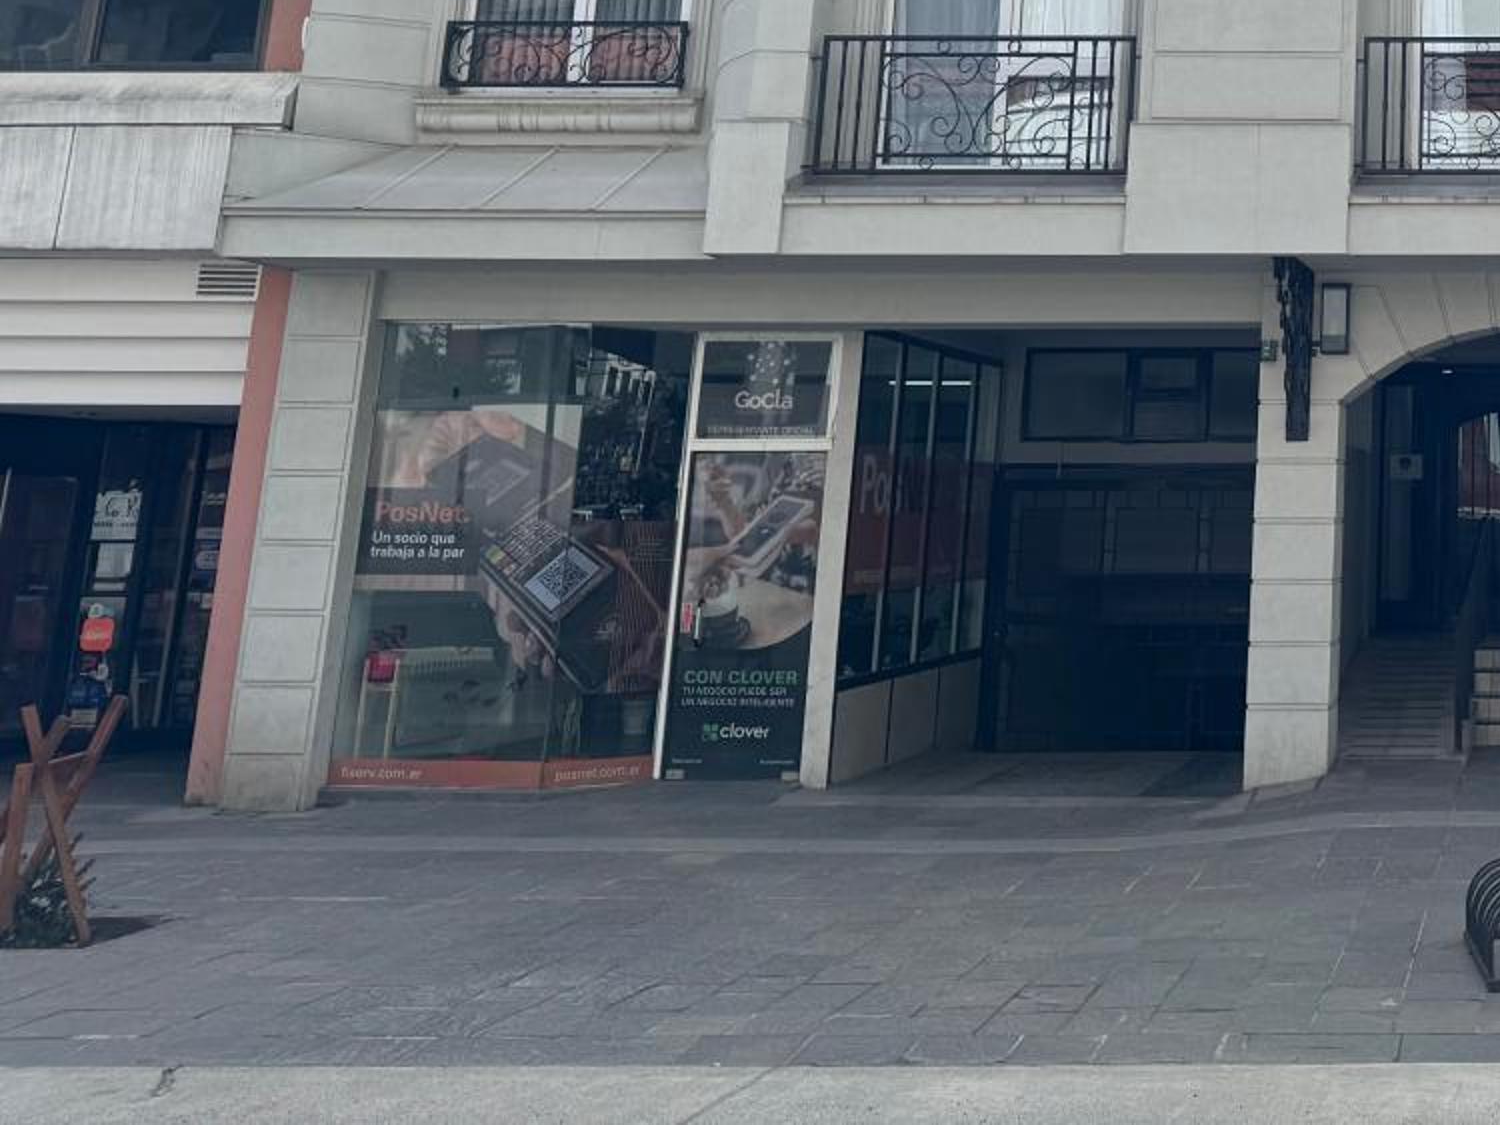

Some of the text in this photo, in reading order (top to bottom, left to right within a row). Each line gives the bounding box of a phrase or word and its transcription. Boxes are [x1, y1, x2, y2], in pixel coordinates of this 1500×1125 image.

[371, 530, 455, 547] Un socio que
[369, 545, 465, 562] trabaja a la par
[683, 669, 798, 686] CON CLOVER
[719, 722, 770, 739] clover
